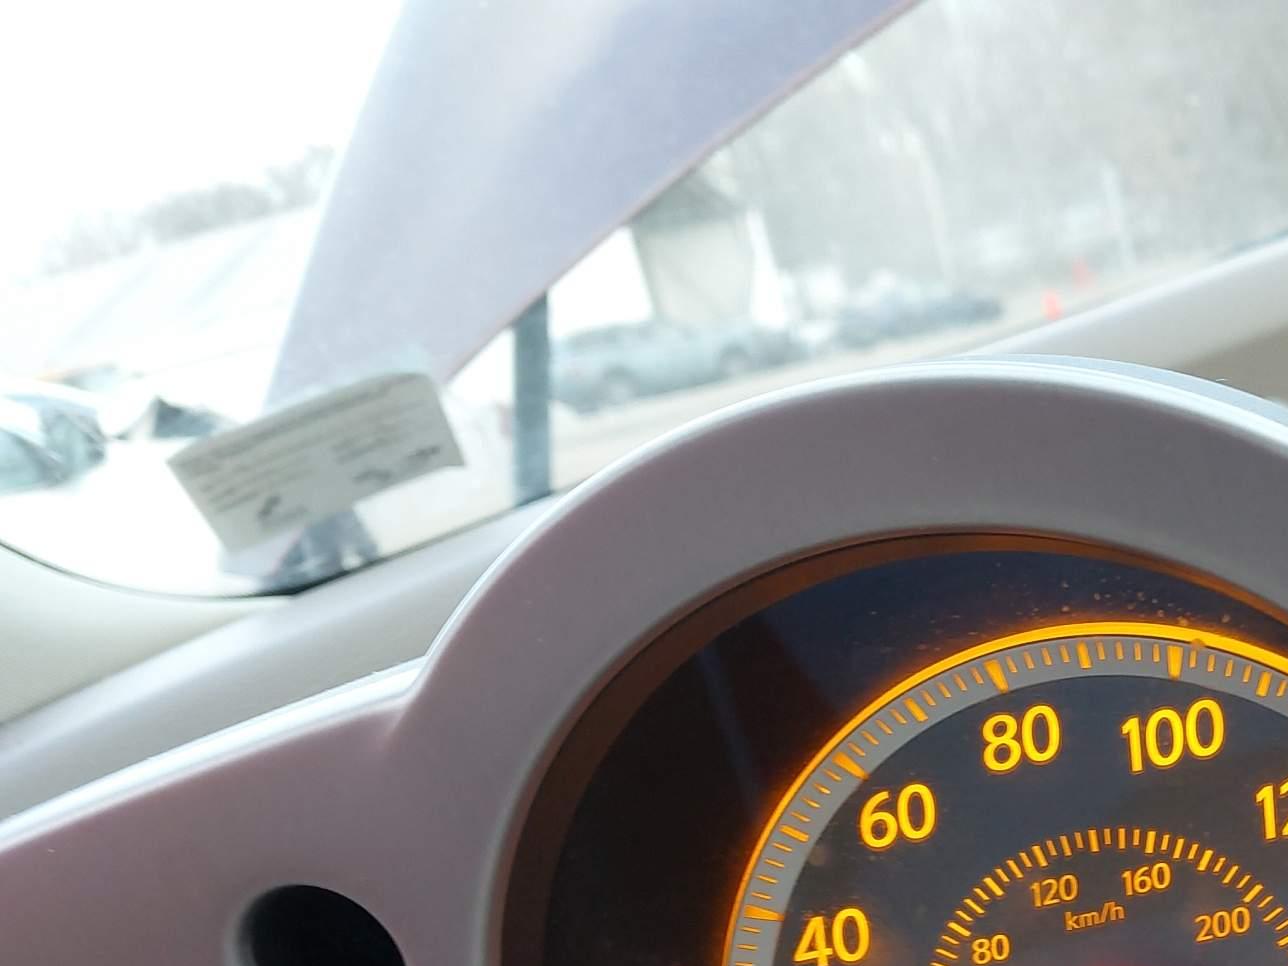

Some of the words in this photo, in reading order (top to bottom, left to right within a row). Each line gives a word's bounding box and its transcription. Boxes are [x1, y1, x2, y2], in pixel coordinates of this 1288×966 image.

[981, 704, 1061, 773] 80
[1121, 698, 1225, 774] 100
[860, 783, 937, 849] 60
[1030, 874, 1079, 908] 120
[1121, 861, 1172, 896] 160
[1065, 902, 1125, 931] km/h
[1194, 906, 1251, 942] 200
[972, 933, 1010, 966] 80
